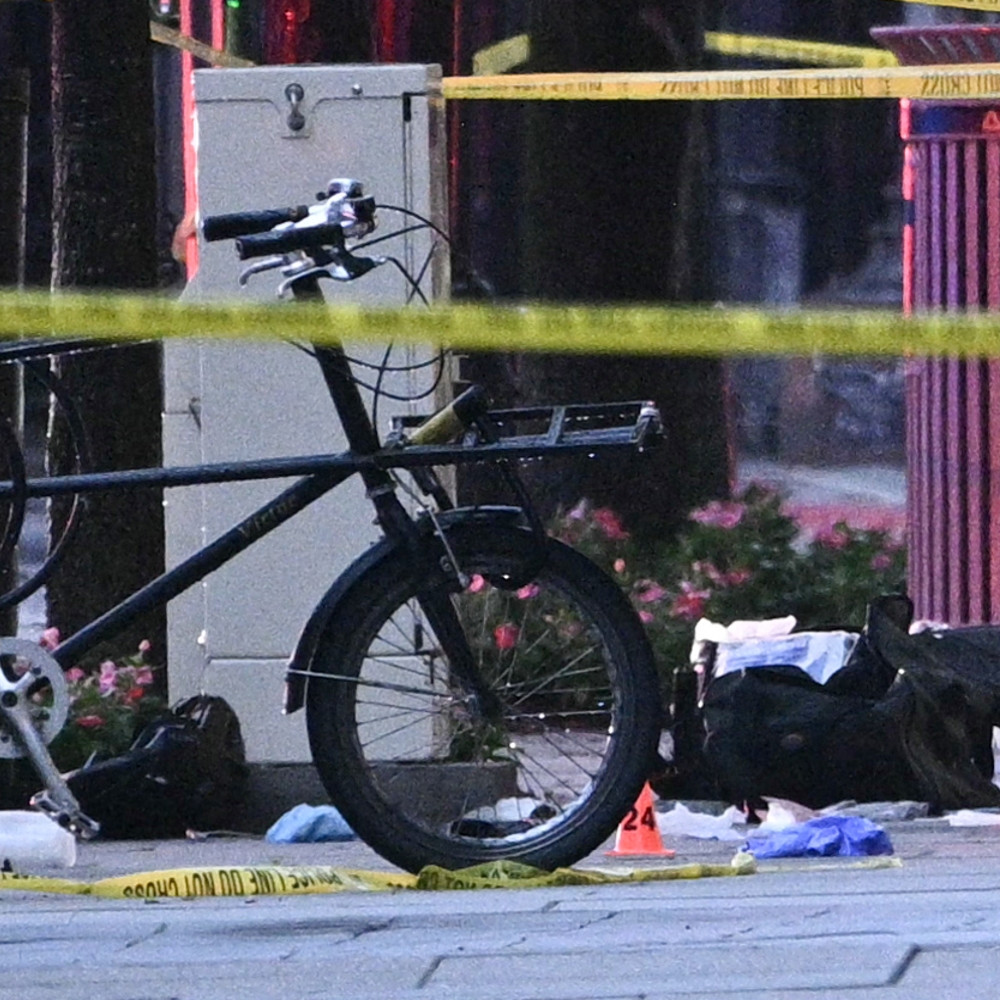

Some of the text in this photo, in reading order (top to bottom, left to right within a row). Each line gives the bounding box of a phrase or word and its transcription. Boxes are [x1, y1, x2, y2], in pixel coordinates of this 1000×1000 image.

[623, 805, 656, 831] 24
[123, 876, 179, 898] CROSS
[184, 872, 215, 897] NOT
[218, 868, 243, 896] DO
[249, 867, 287, 894] LINE
